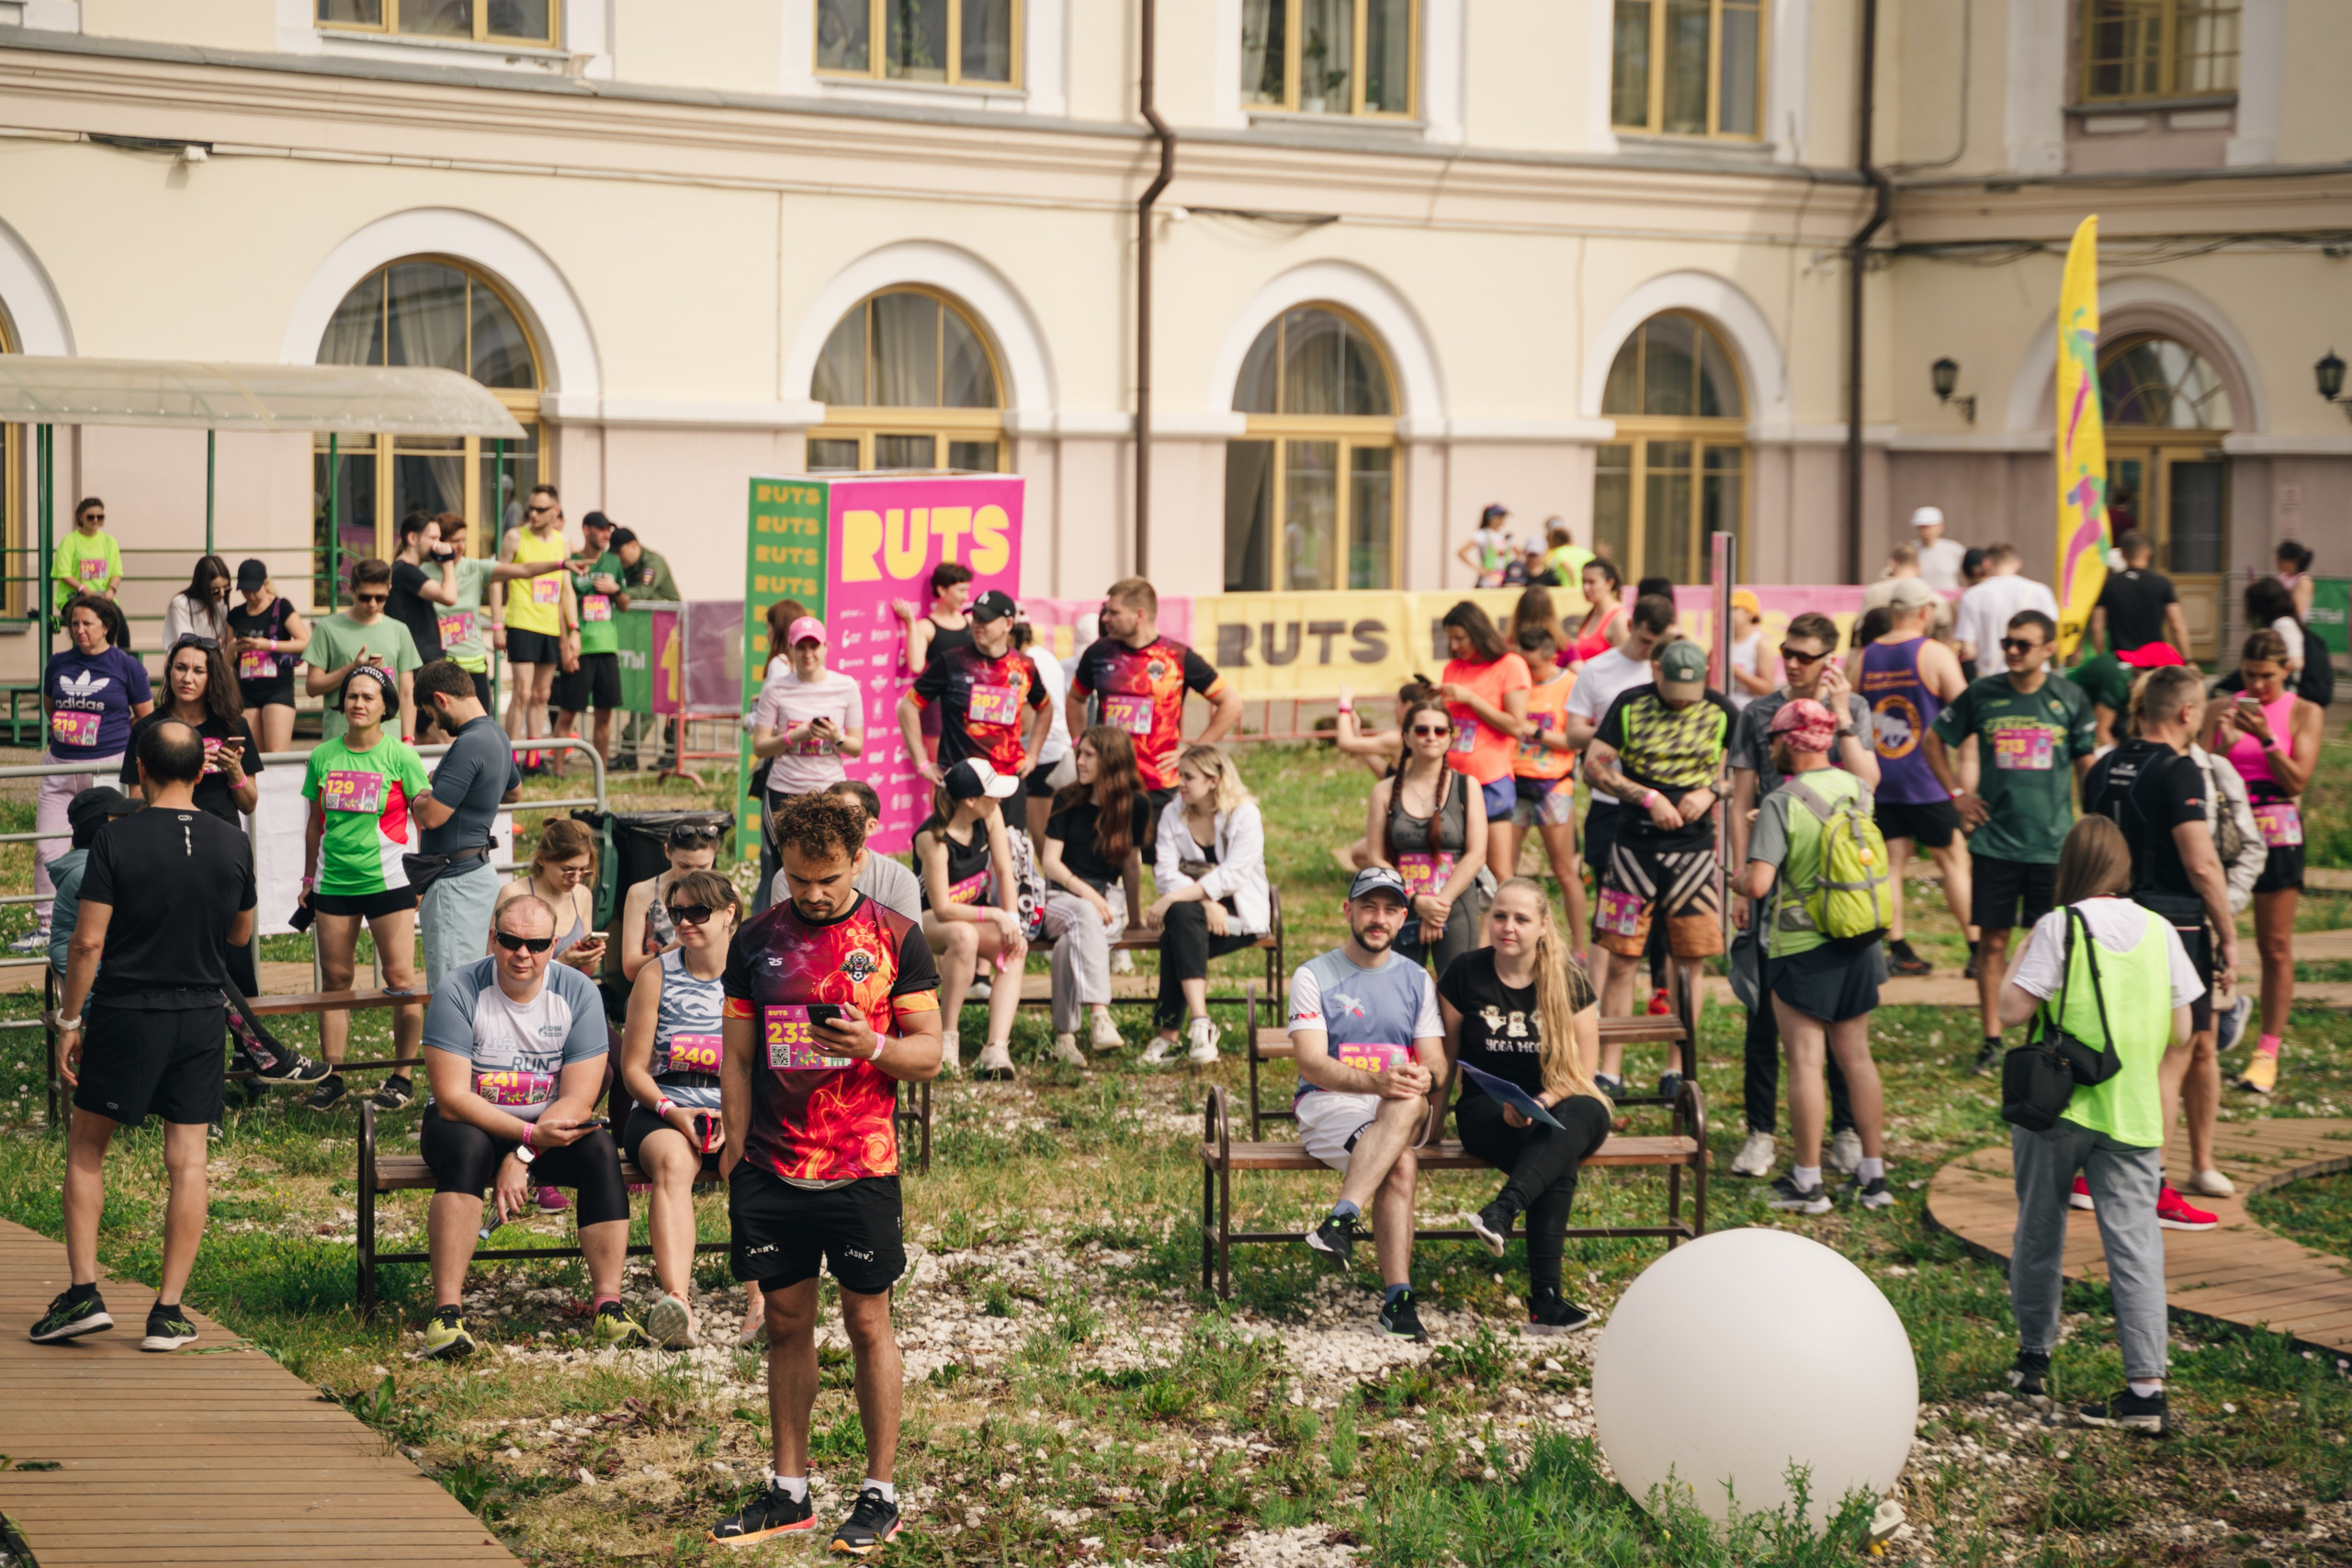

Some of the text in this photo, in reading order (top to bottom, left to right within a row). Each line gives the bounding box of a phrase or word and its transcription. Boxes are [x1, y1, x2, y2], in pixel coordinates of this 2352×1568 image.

[756, 484, 821, 505] RUTS
[755, 513, 820, 536] RUTS
[841, 504, 1011, 582] RUTS
[754, 544, 820, 566] RUTS
[753, 574, 818, 596] RUTS
[1216, 619, 1389, 668] RUTS
[55, 696, 105, 711] adidas
[52, 717, 78, 732] 219
[327, 780, 356, 795] 129
[1400, 863, 1431, 880] 259
[1486, 1038, 1514, 1053] YOGA
[511, 1055, 551, 1072] RUN
[671, 1045, 717, 1066] 240
[480, 1071, 518, 1088] 241
[749, 1243, 775, 1255] ASRV
[848, 1248, 870, 1261] ASRV
